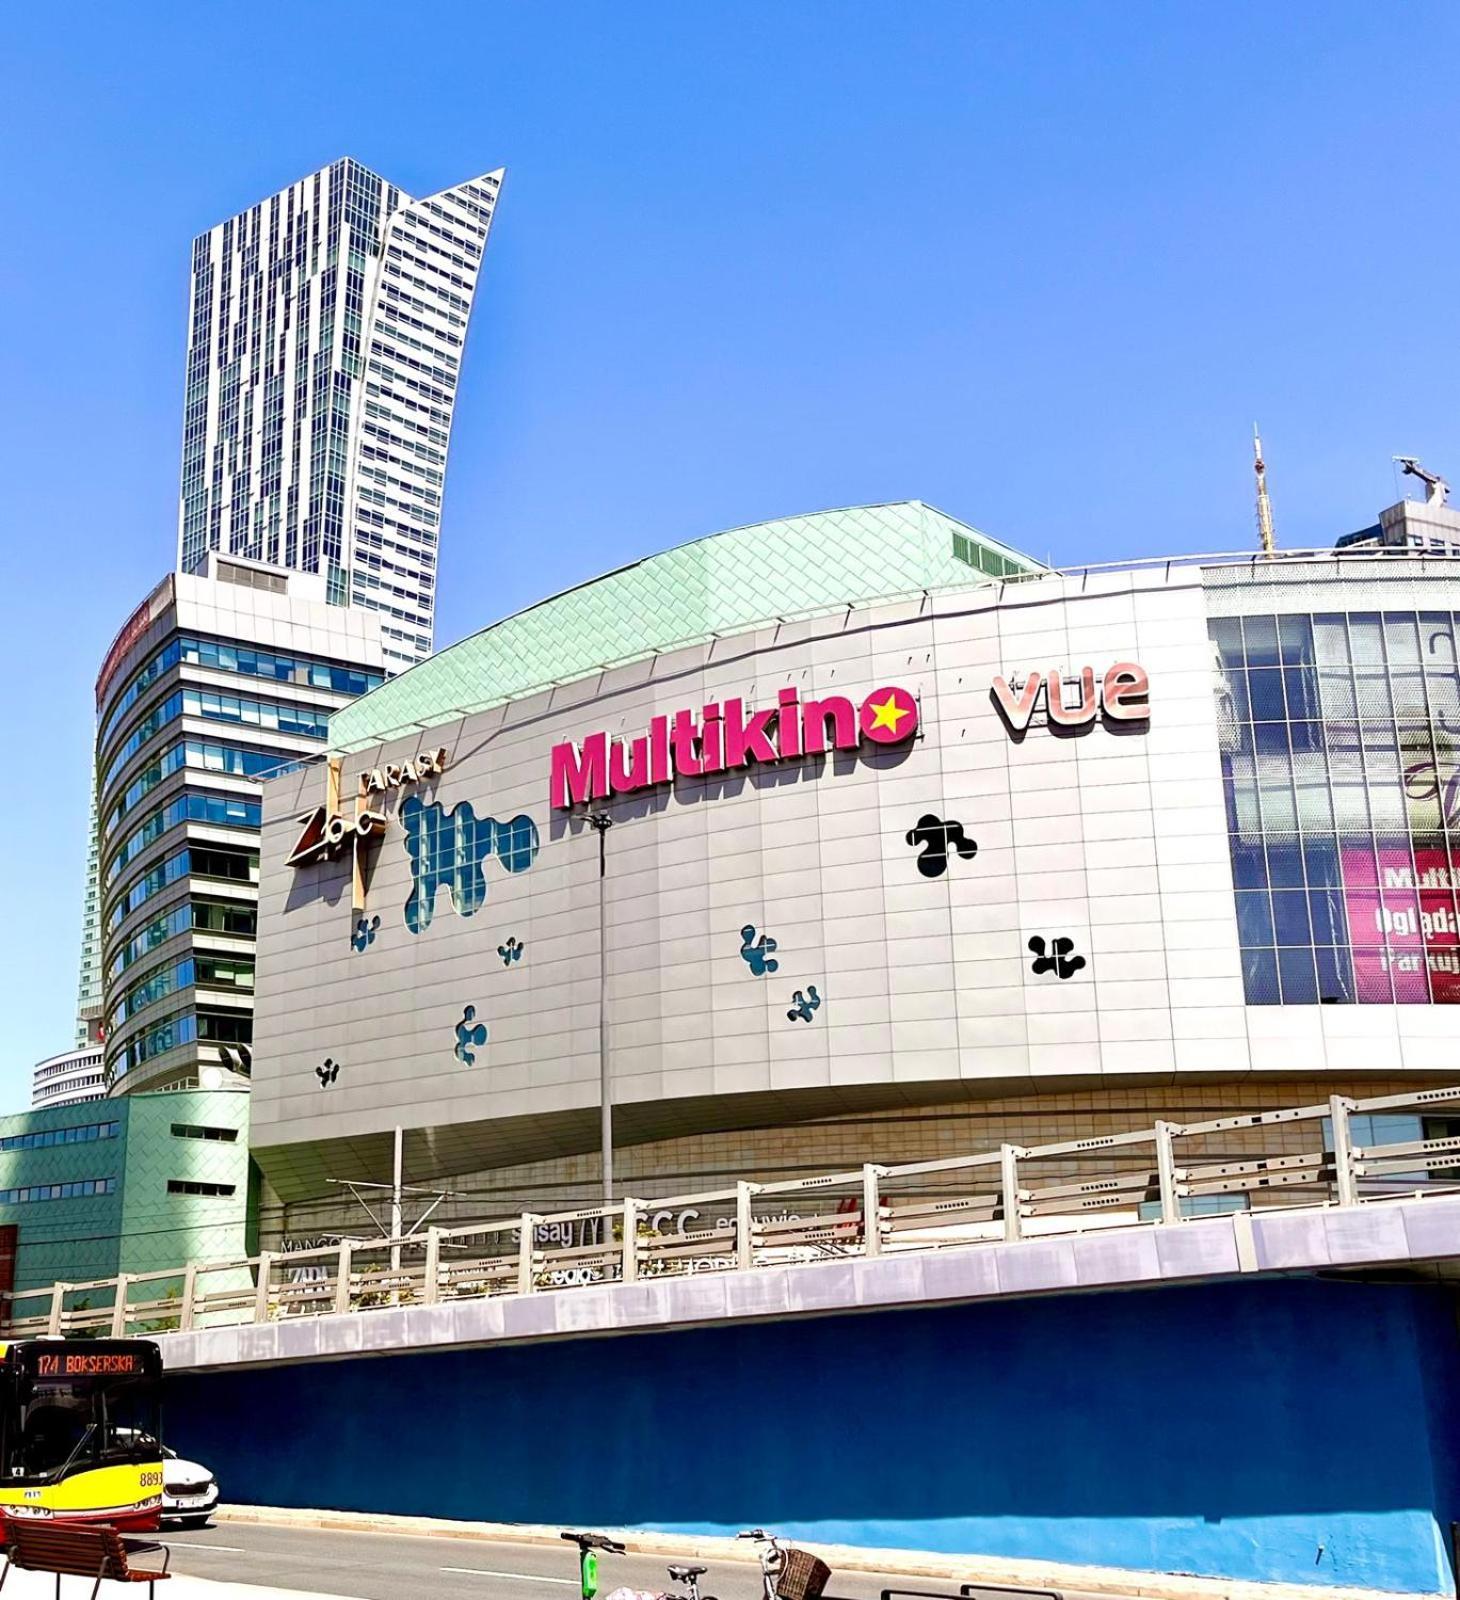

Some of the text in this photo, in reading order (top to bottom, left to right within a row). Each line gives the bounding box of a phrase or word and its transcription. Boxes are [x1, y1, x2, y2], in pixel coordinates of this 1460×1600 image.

[550, 686, 918, 809] Multikino
[66, 1354, 133, 1373] BOKSERSKA
[140, 1472, 162, 1487] 8893
